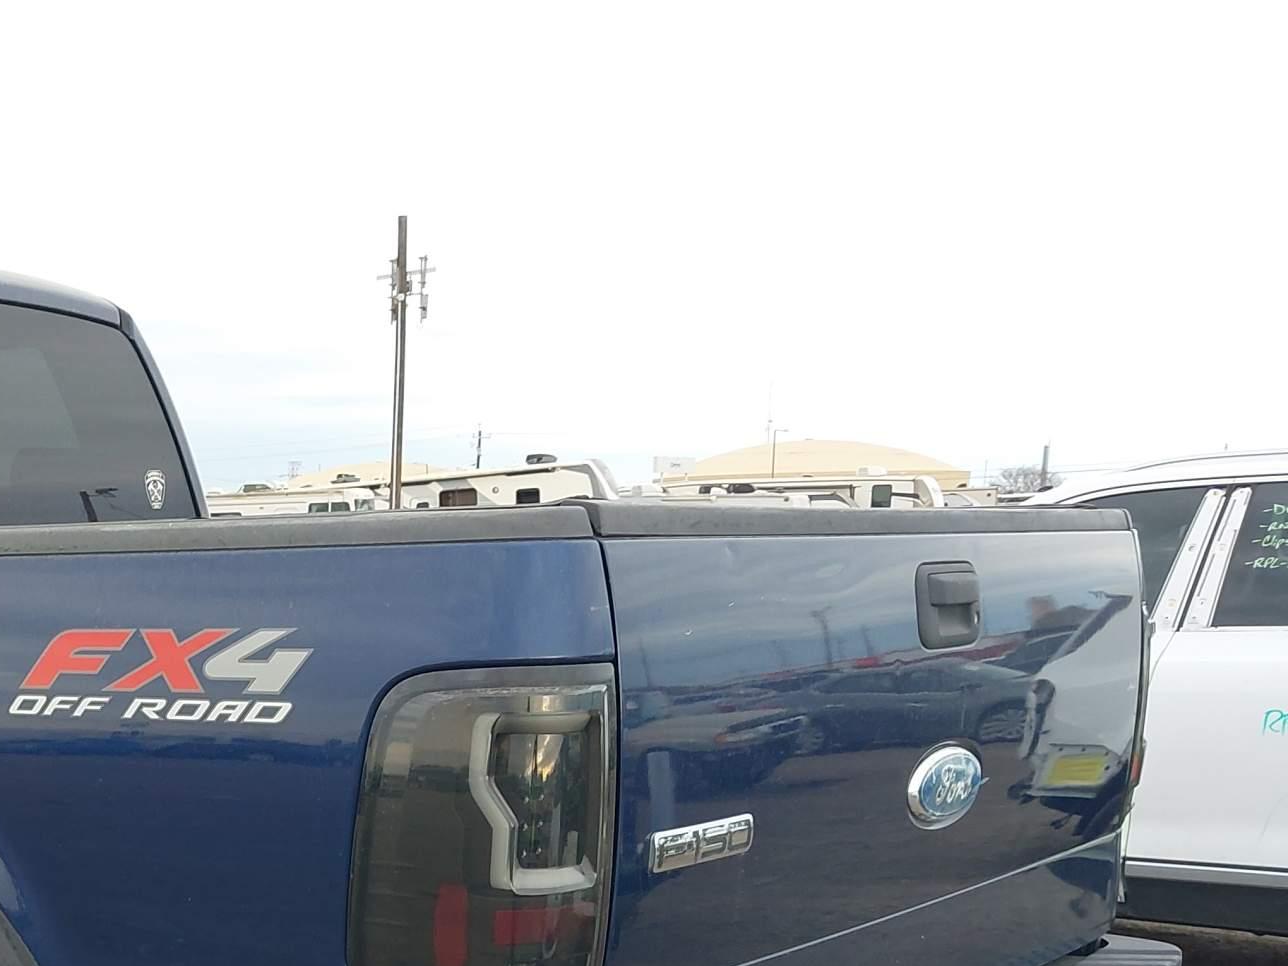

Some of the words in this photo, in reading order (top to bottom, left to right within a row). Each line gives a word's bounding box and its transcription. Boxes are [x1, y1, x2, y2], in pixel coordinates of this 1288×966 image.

[19, 628, 314, 695] FX4
[9, 694, 111, 717] OFF
[120, 698, 293, 724] ROAD
[935, 759, 975, 806] Ford
